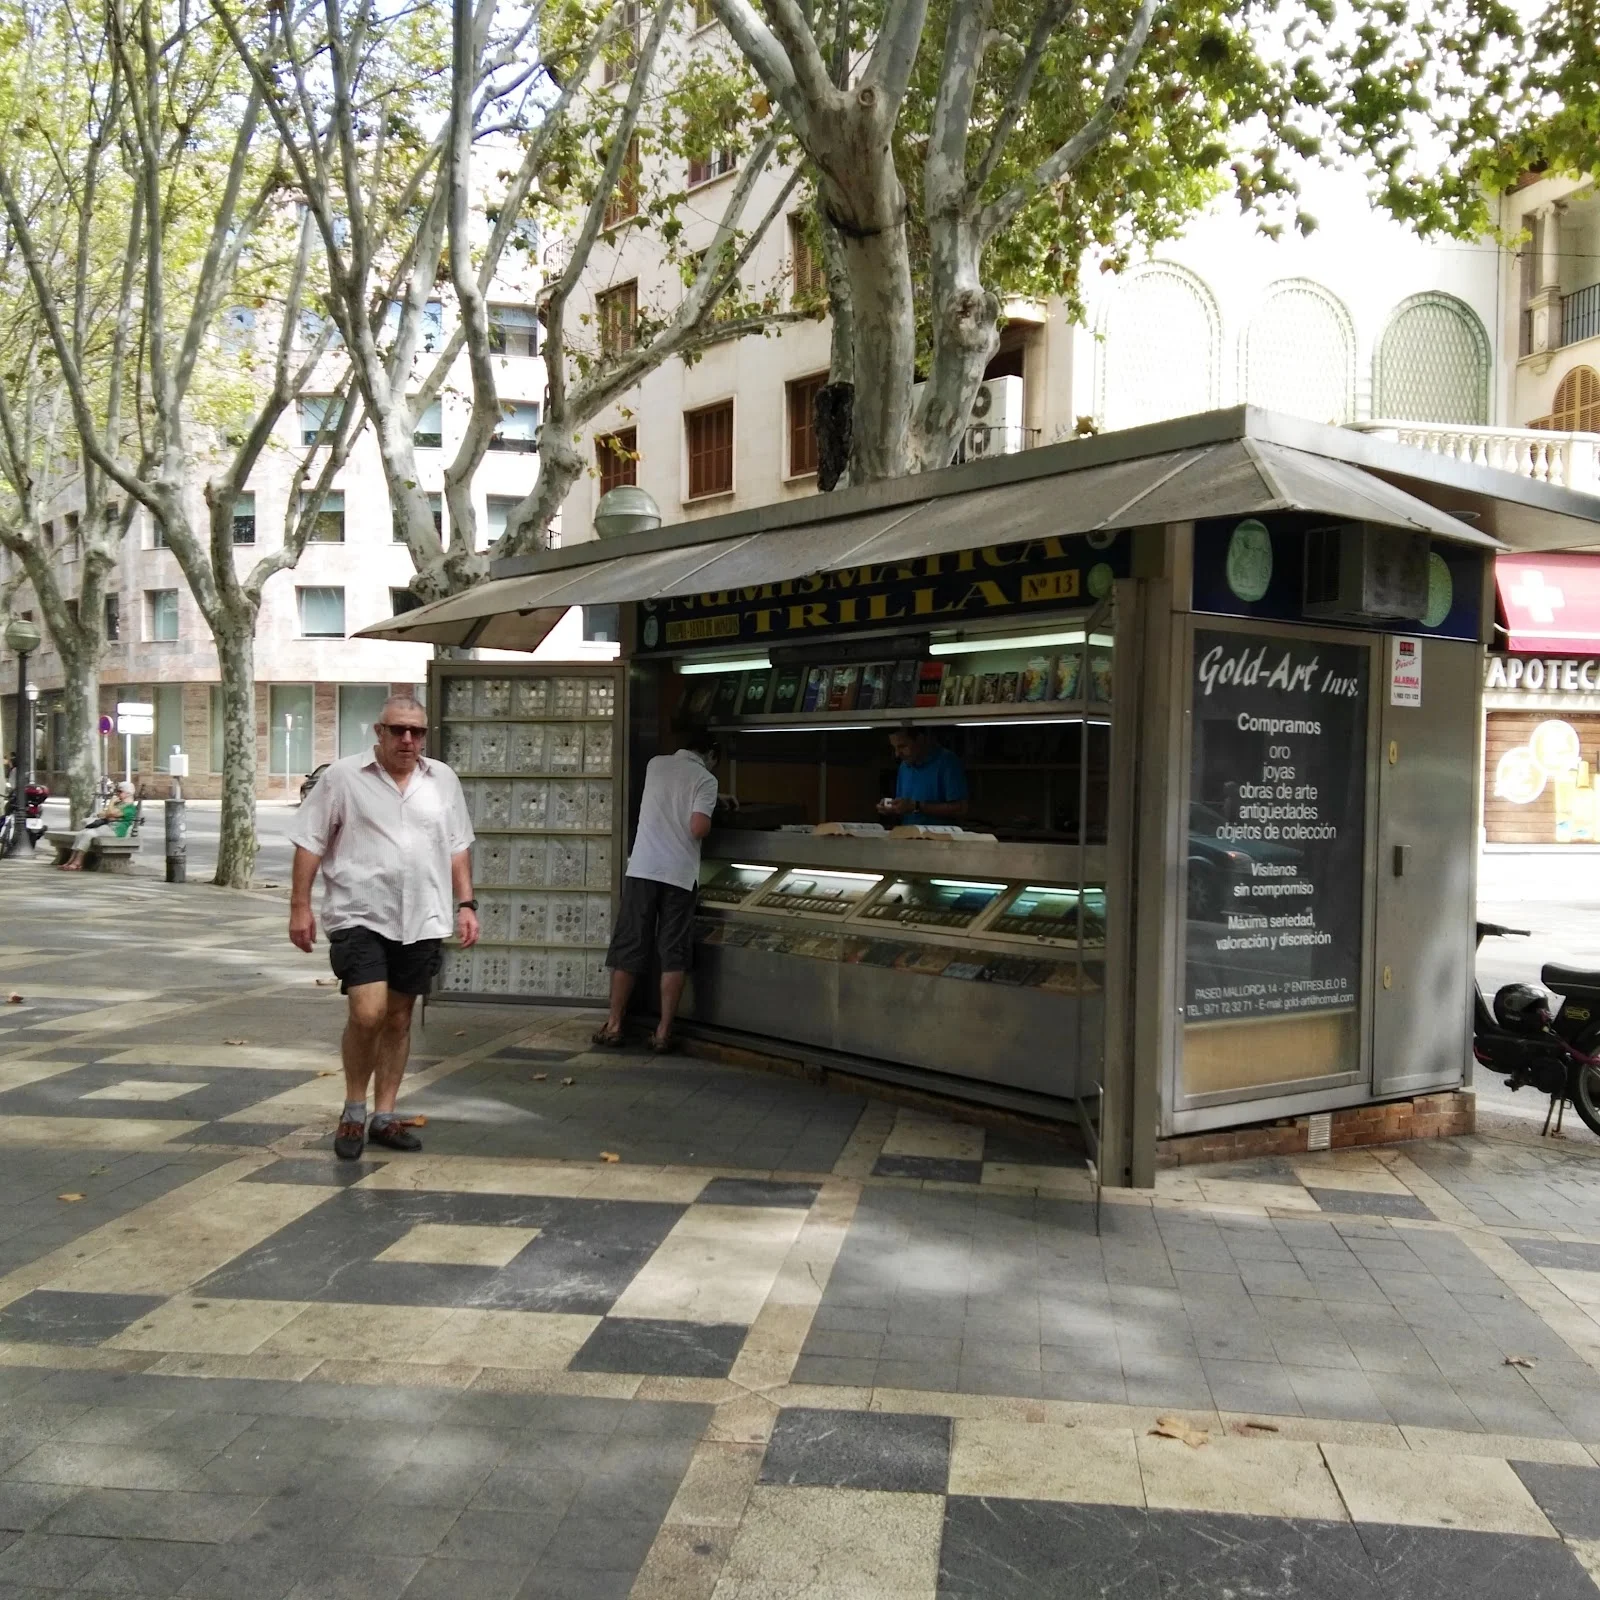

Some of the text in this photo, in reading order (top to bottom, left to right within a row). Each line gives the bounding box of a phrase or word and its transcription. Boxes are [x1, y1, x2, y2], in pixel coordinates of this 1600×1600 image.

[1055, 573, 1073, 595] 13
[744, 580, 1014, 634] TRILLA
[1199, 646, 1319, 695] Gold-Art
[1394, 676, 1419, 685] ALARMA
[1237, 712, 1321, 735] Compramos
[1269, 745, 1291, 760] oro
[1262, 763, 1295, 782] joyas
[1239, 782, 1317, 800] obras de arte
[1239, 803, 1318, 823] antigüedades
[1216, 823, 1337, 843] objetos de colección
[1233, 881, 1314, 898] sin compromiso
[1228, 913, 1316, 930] Máxima seriedad,
[1216, 932, 1331, 950] valoración y discreción
[1195, 987, 1222, 1000] PASEO
[1222, 984, 1266, 998] MALLORCA
[1267, 983, 1277, 993] 14
[1291, 979, 1338, 993] ENTRESUELO
[1204, 1002, 1220, 1015] 971
